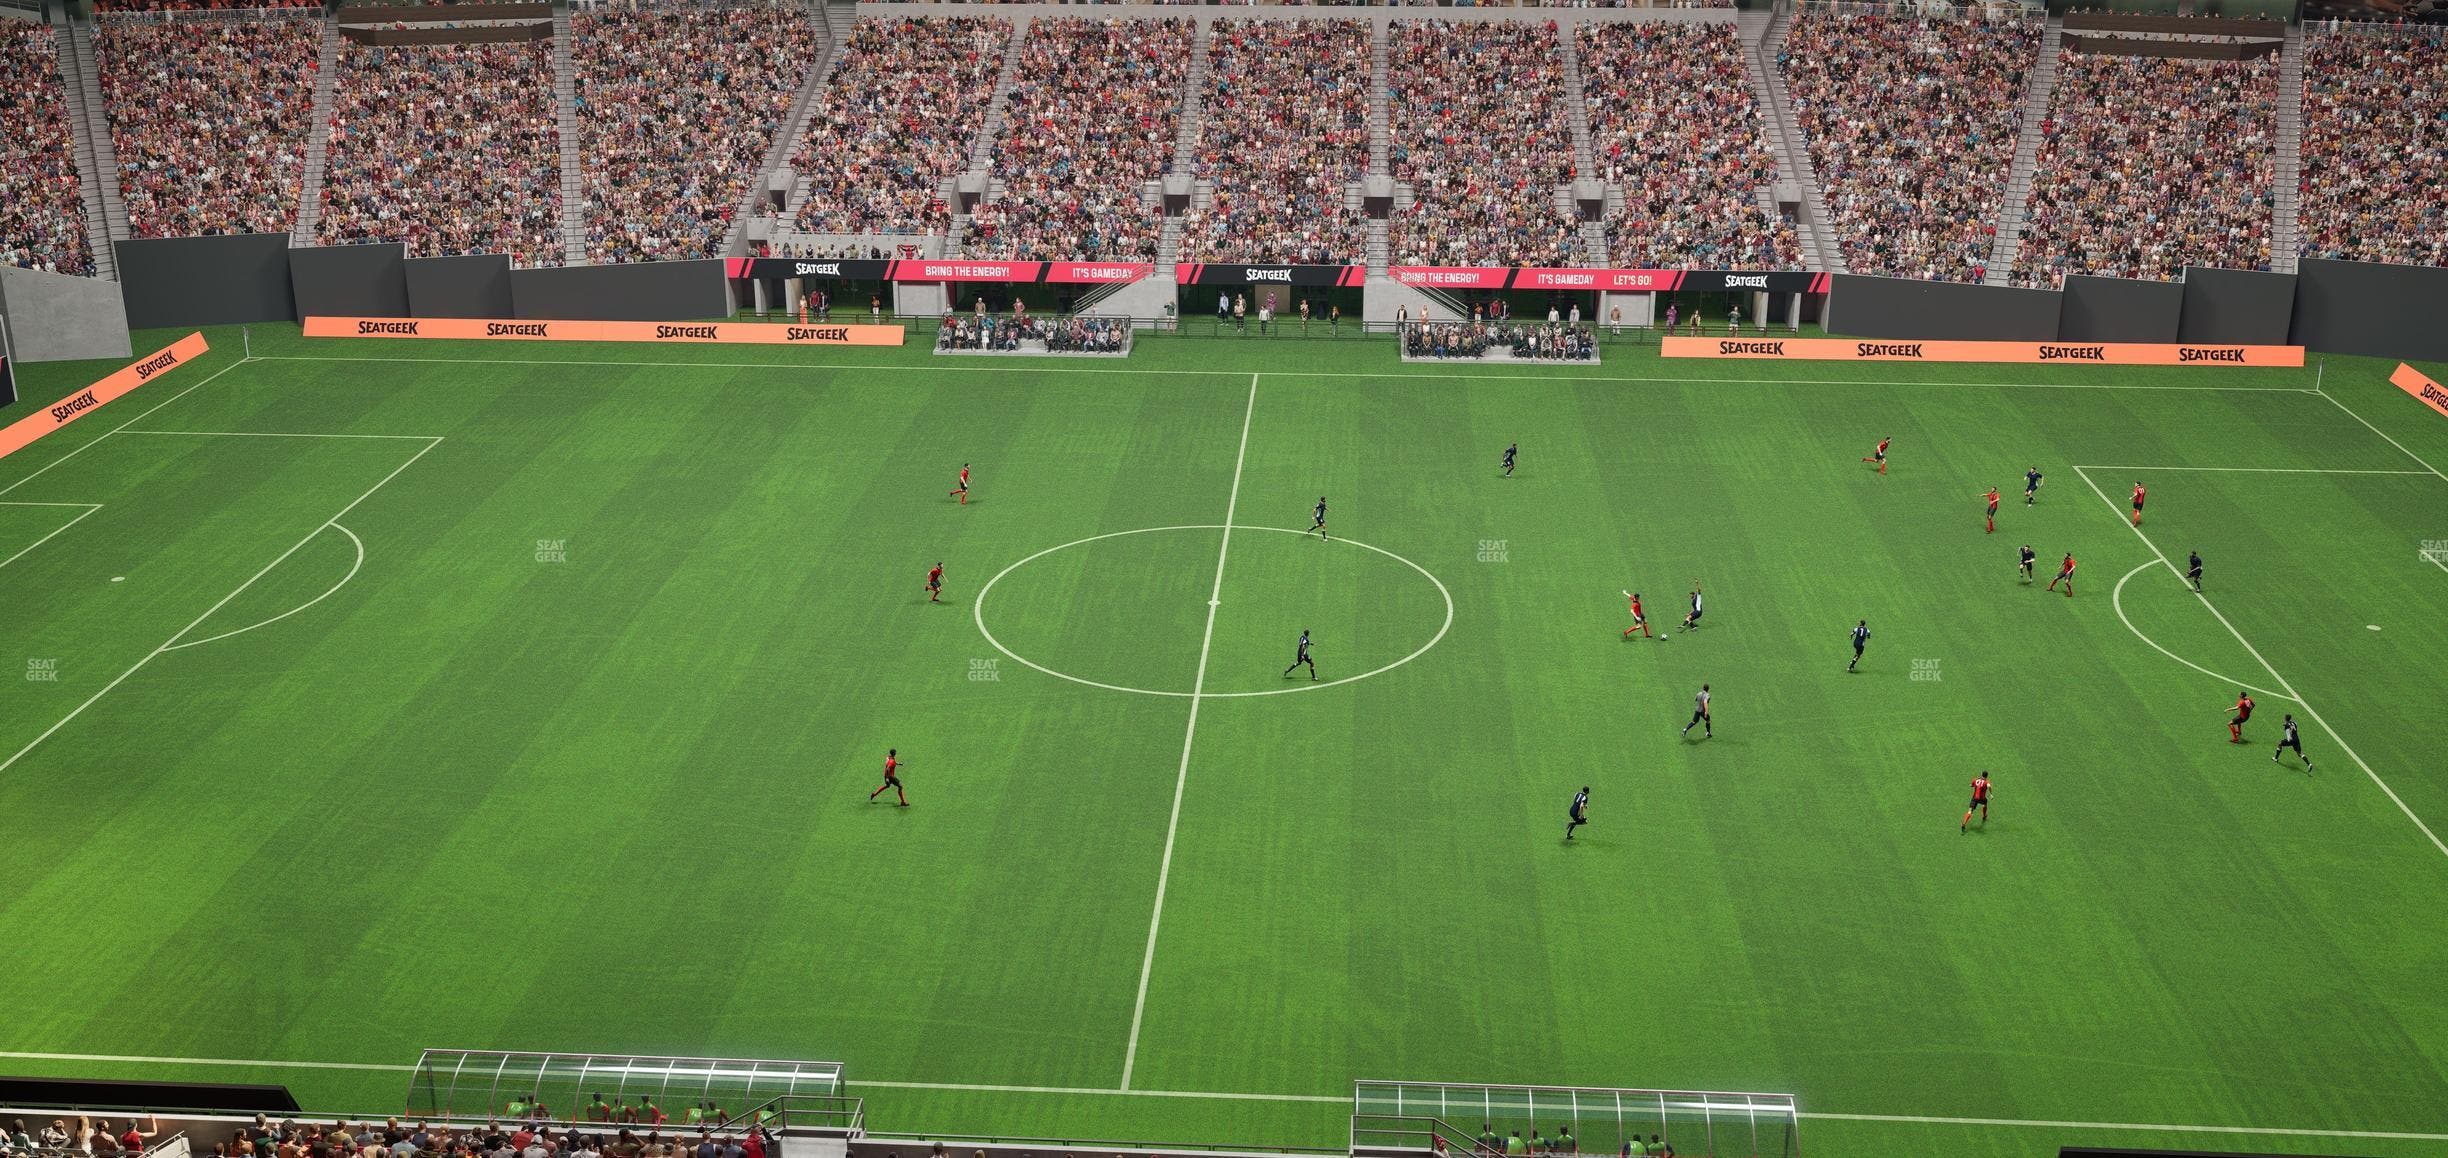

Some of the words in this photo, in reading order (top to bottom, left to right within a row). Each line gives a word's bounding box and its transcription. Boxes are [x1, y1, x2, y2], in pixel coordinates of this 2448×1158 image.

[796, 262, 841, 276] SEATGEEK
[925, 266, 953, 277] BRING
[954, 266, 971, 277] THE
[973, 266, 1010, 278] ENERGY!
[1072, 267, 1090, 279] IT'S
[1091, 268, 1134, 279] GAMEDAY
[1246, 268, 1292, 282] SEATGEEK
[1428, 272, 1444, 283] THE
[1444, 273, 1480, 284] ENERGY!
[1538, 274, 1554, 285] IT'S
[1555, 274, 1595, 286] GAMEDAY
[1613, 275, 1636, 286] LET'S
[1637, 275, 1653, 286] GO!
[1725, 274, 1768, 288] SEATGEEK
[358, 321, 418, 335] SEATGEEK
[487, 322, 548, 337] SEATGEEK
[656, 325, 718, 339] SEATGEEK
[787, 327, 848, 342] SEATGEEK
[1720, 341, 1784, 356] SEATGEEK
[1857, 342, 1922, 358] SEATGEEK
[2039, 345, 2104, 360] SEATGEEK
[2179, 347, 2245, 363] SEATGEEK
[135, 350, 178, 380] SEATGEEK
[51, 390, 99, 423] SEATGEEK
